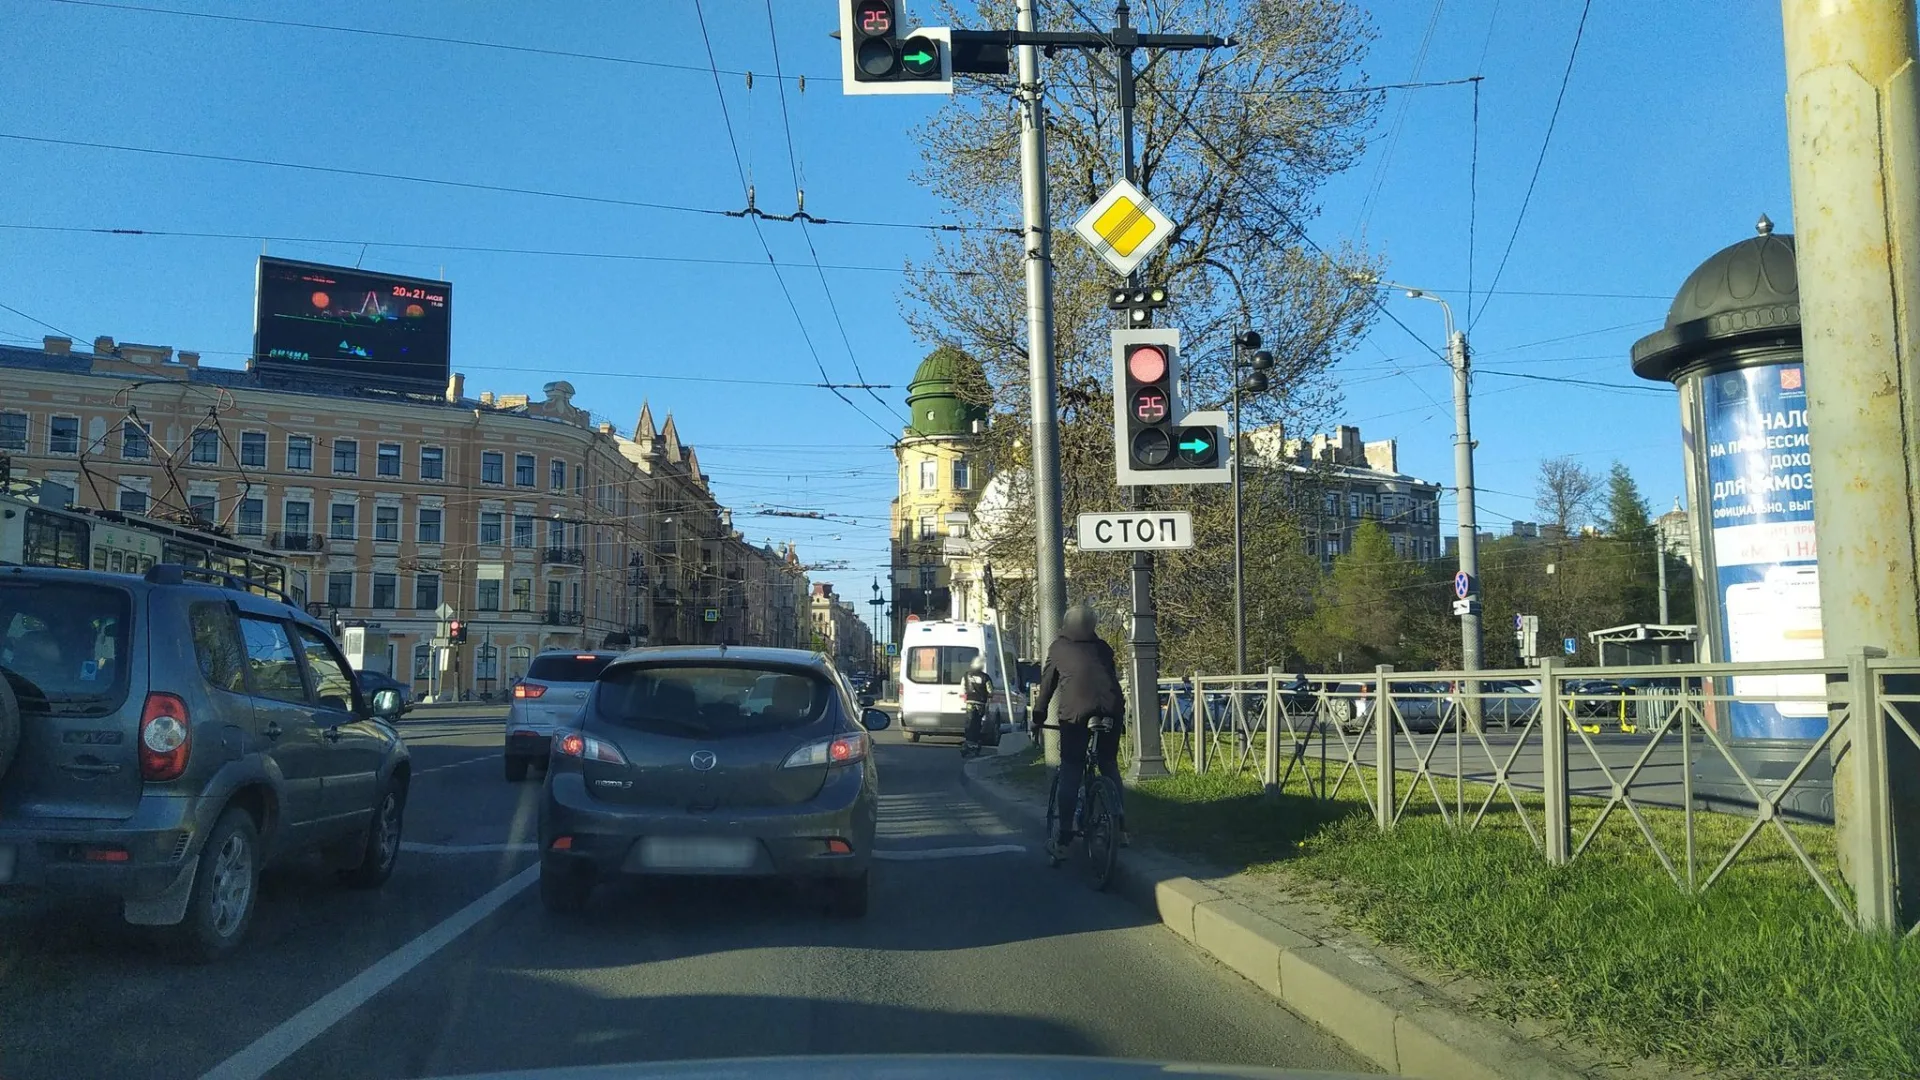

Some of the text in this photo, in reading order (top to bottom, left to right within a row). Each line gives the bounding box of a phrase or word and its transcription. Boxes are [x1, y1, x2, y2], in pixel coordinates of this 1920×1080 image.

[864, 11, 888, 30] 25
[392, 286, 406, 297] 20
[413, 289, 425, 300] 21
[1138, 396, 1164, 417] 25
[1710, 434, 1810, 457] НА ПЕССИ
[1713, 473, 1813, 500] ДЛЯ АМОЗ
[1095, 518, 1177, 543] СТОП
